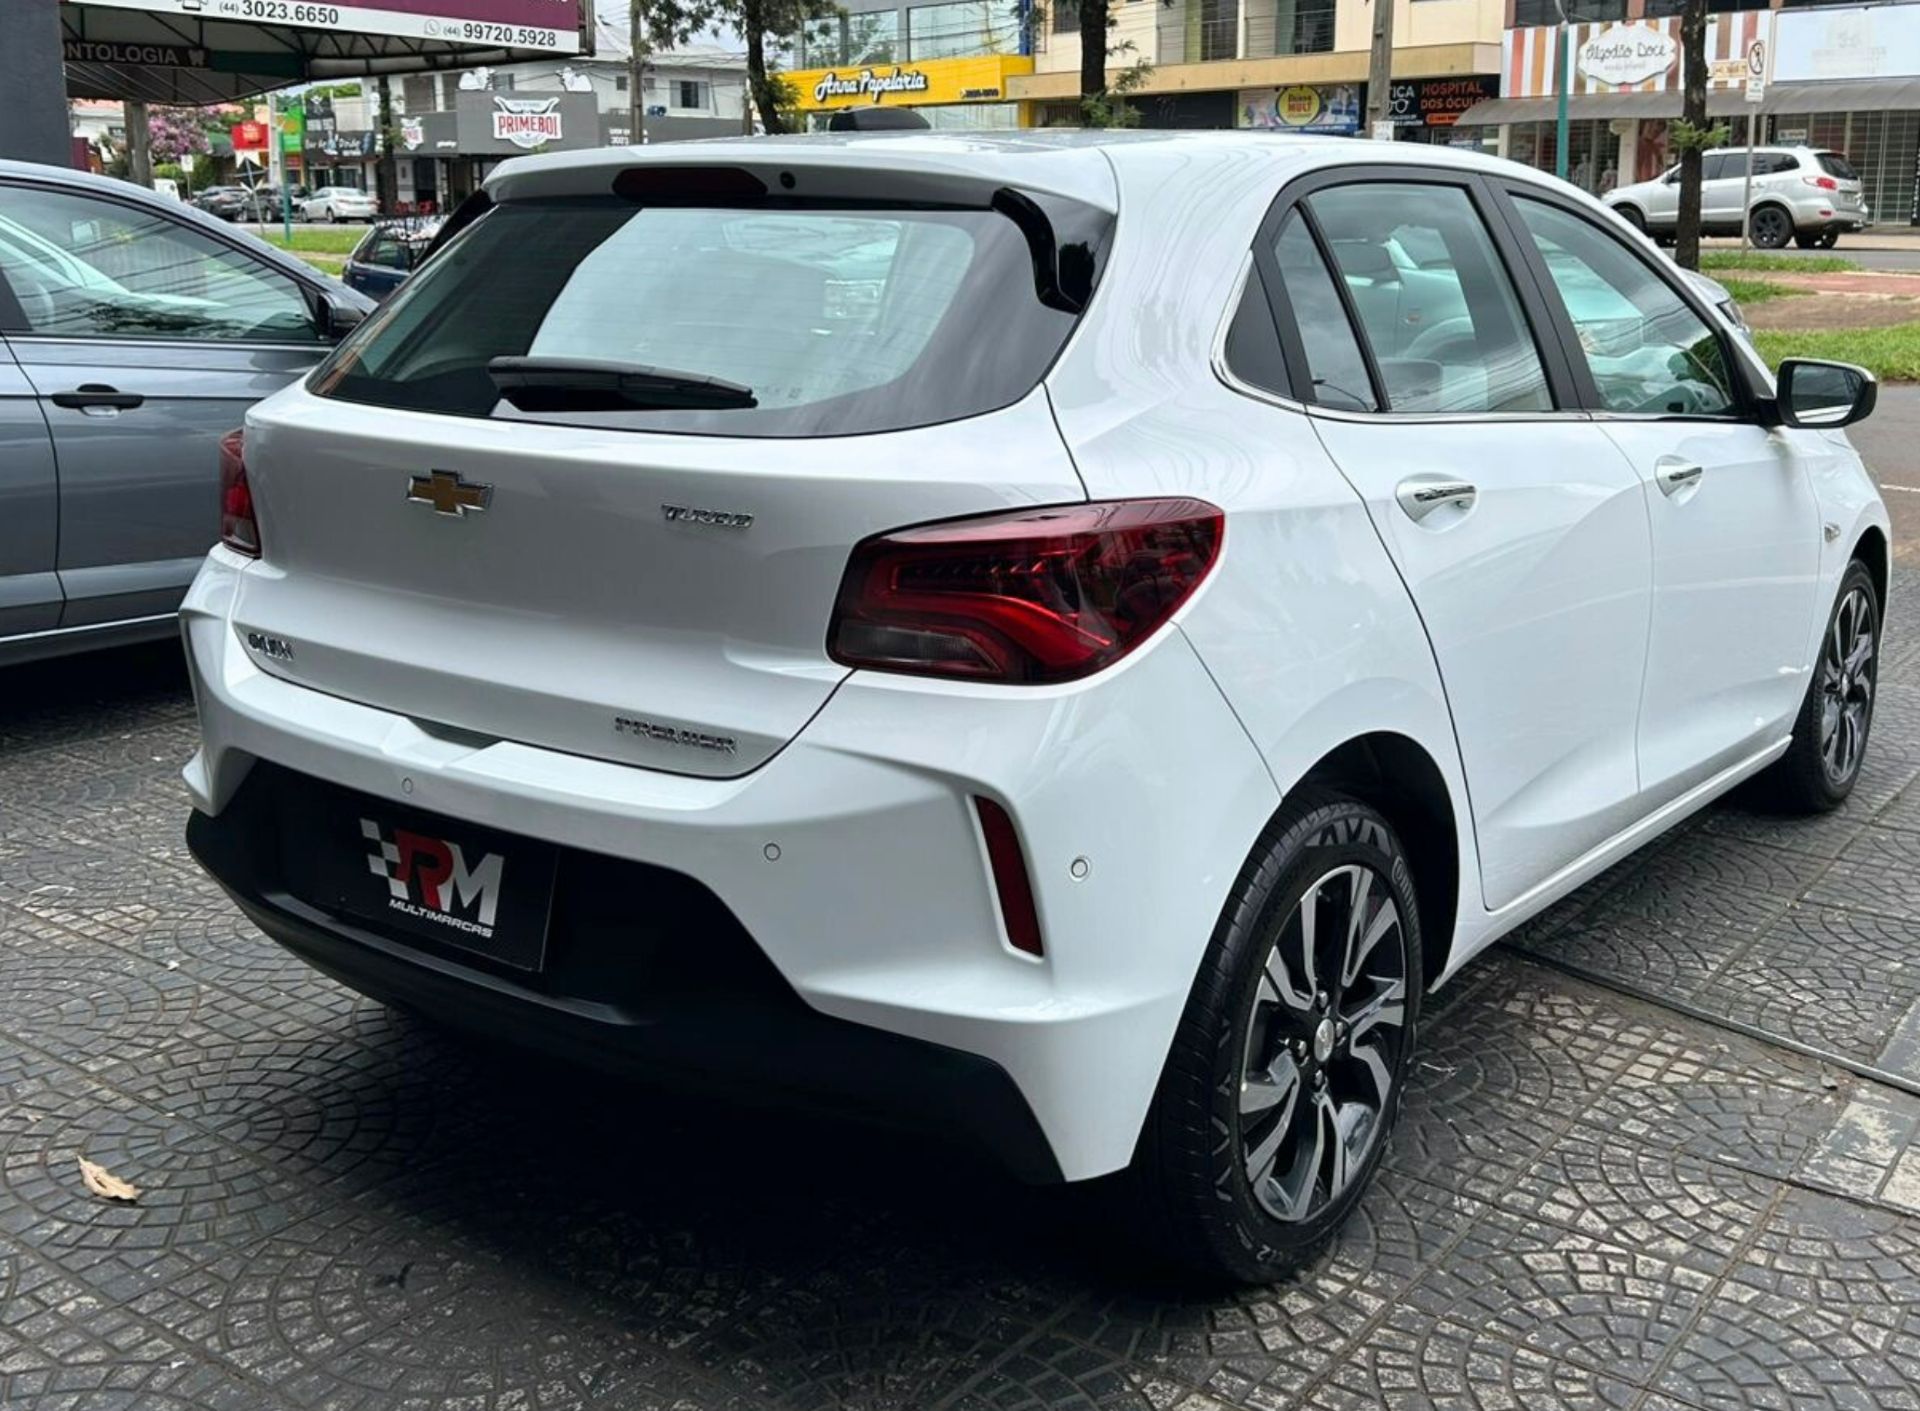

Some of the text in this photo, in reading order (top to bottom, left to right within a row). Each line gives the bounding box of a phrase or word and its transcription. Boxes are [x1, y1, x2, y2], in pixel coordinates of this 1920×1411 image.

[219, 0, 339, 25] (44) 3023.6650
[463, 23, 557, 47] 99720.5928
[66, 41, 179, 65] NTOLOGIA
[1637, 42, 1666, 58] Doce
[814, 68, 927, 104] Anna Papelaria
[1389, 85, 1415, 99] ICA
[1421, 80, 1483, 95] HOSPITAL
[1420, 95, 1492, 110] DOS ÓCULO
[498, 115, 558, 137] PRIMEBOI
[614, 716, 737, 755] PREMIER
[388, 898, 494, 939] MULTIMARCAS
